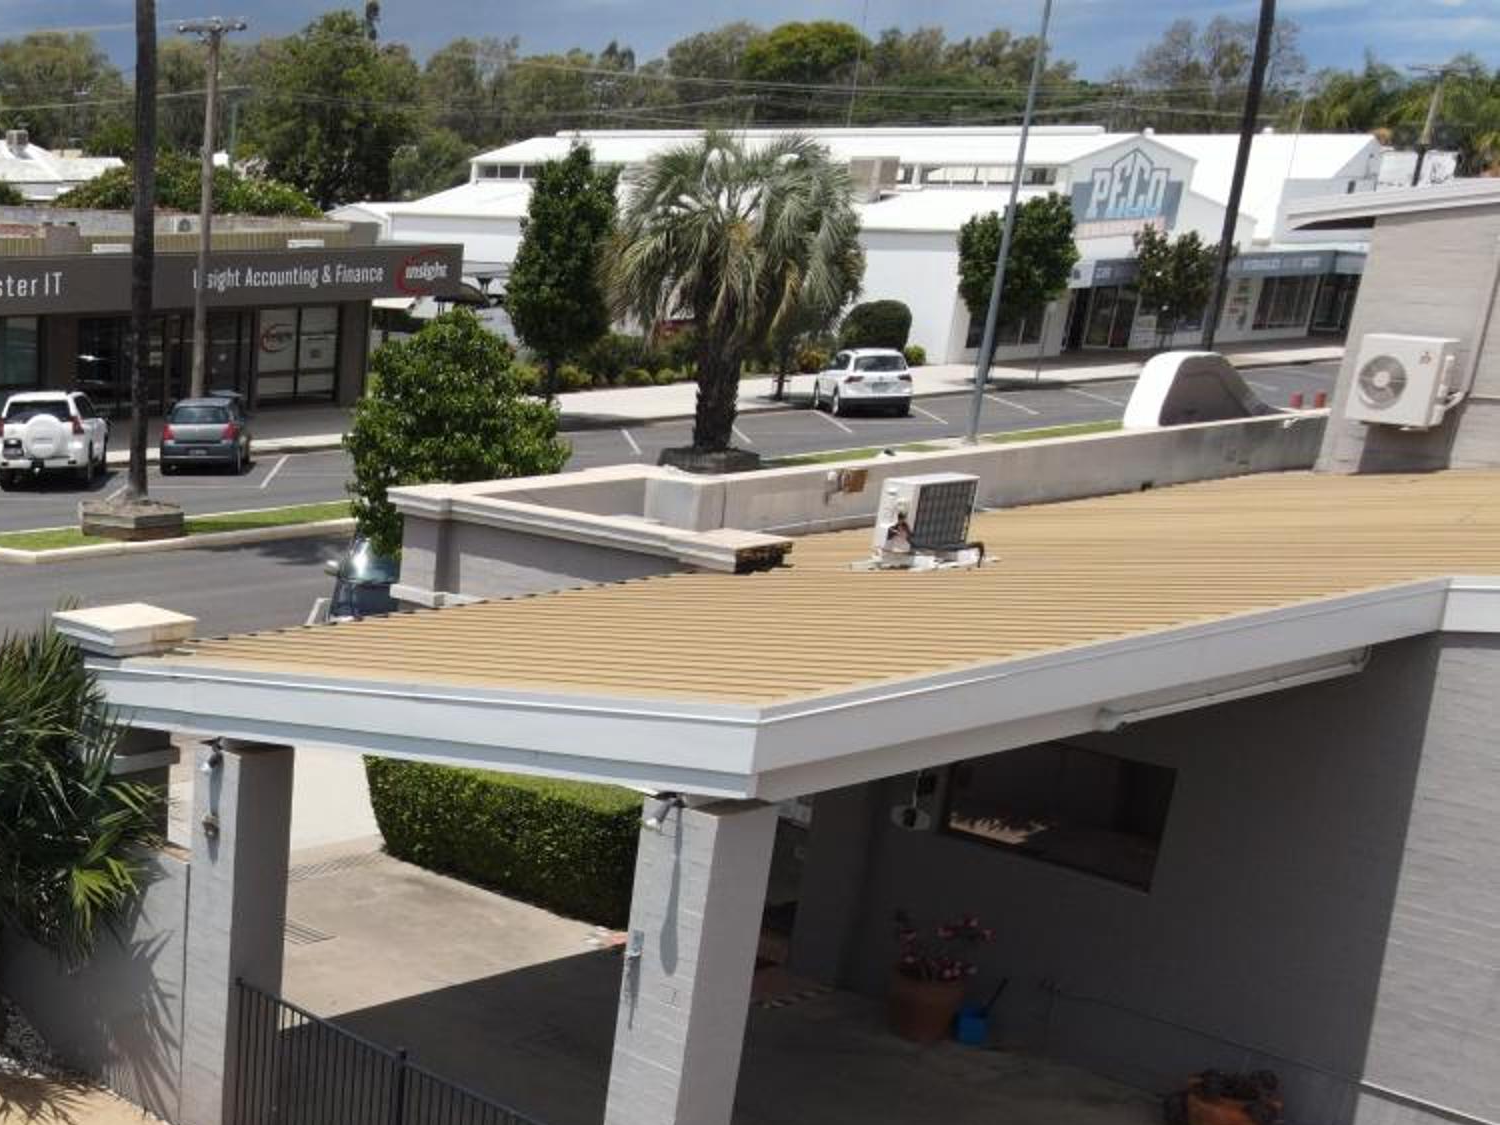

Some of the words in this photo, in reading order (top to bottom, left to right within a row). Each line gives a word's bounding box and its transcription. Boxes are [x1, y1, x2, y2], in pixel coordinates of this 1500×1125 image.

[45, 271, 63, 296] IT
[192, 267, 241, 292] Isight
[243, 265, 319, 289] Accounting
[322, 263, 333, 284] &
[335, 263, 384, 284] Finance
